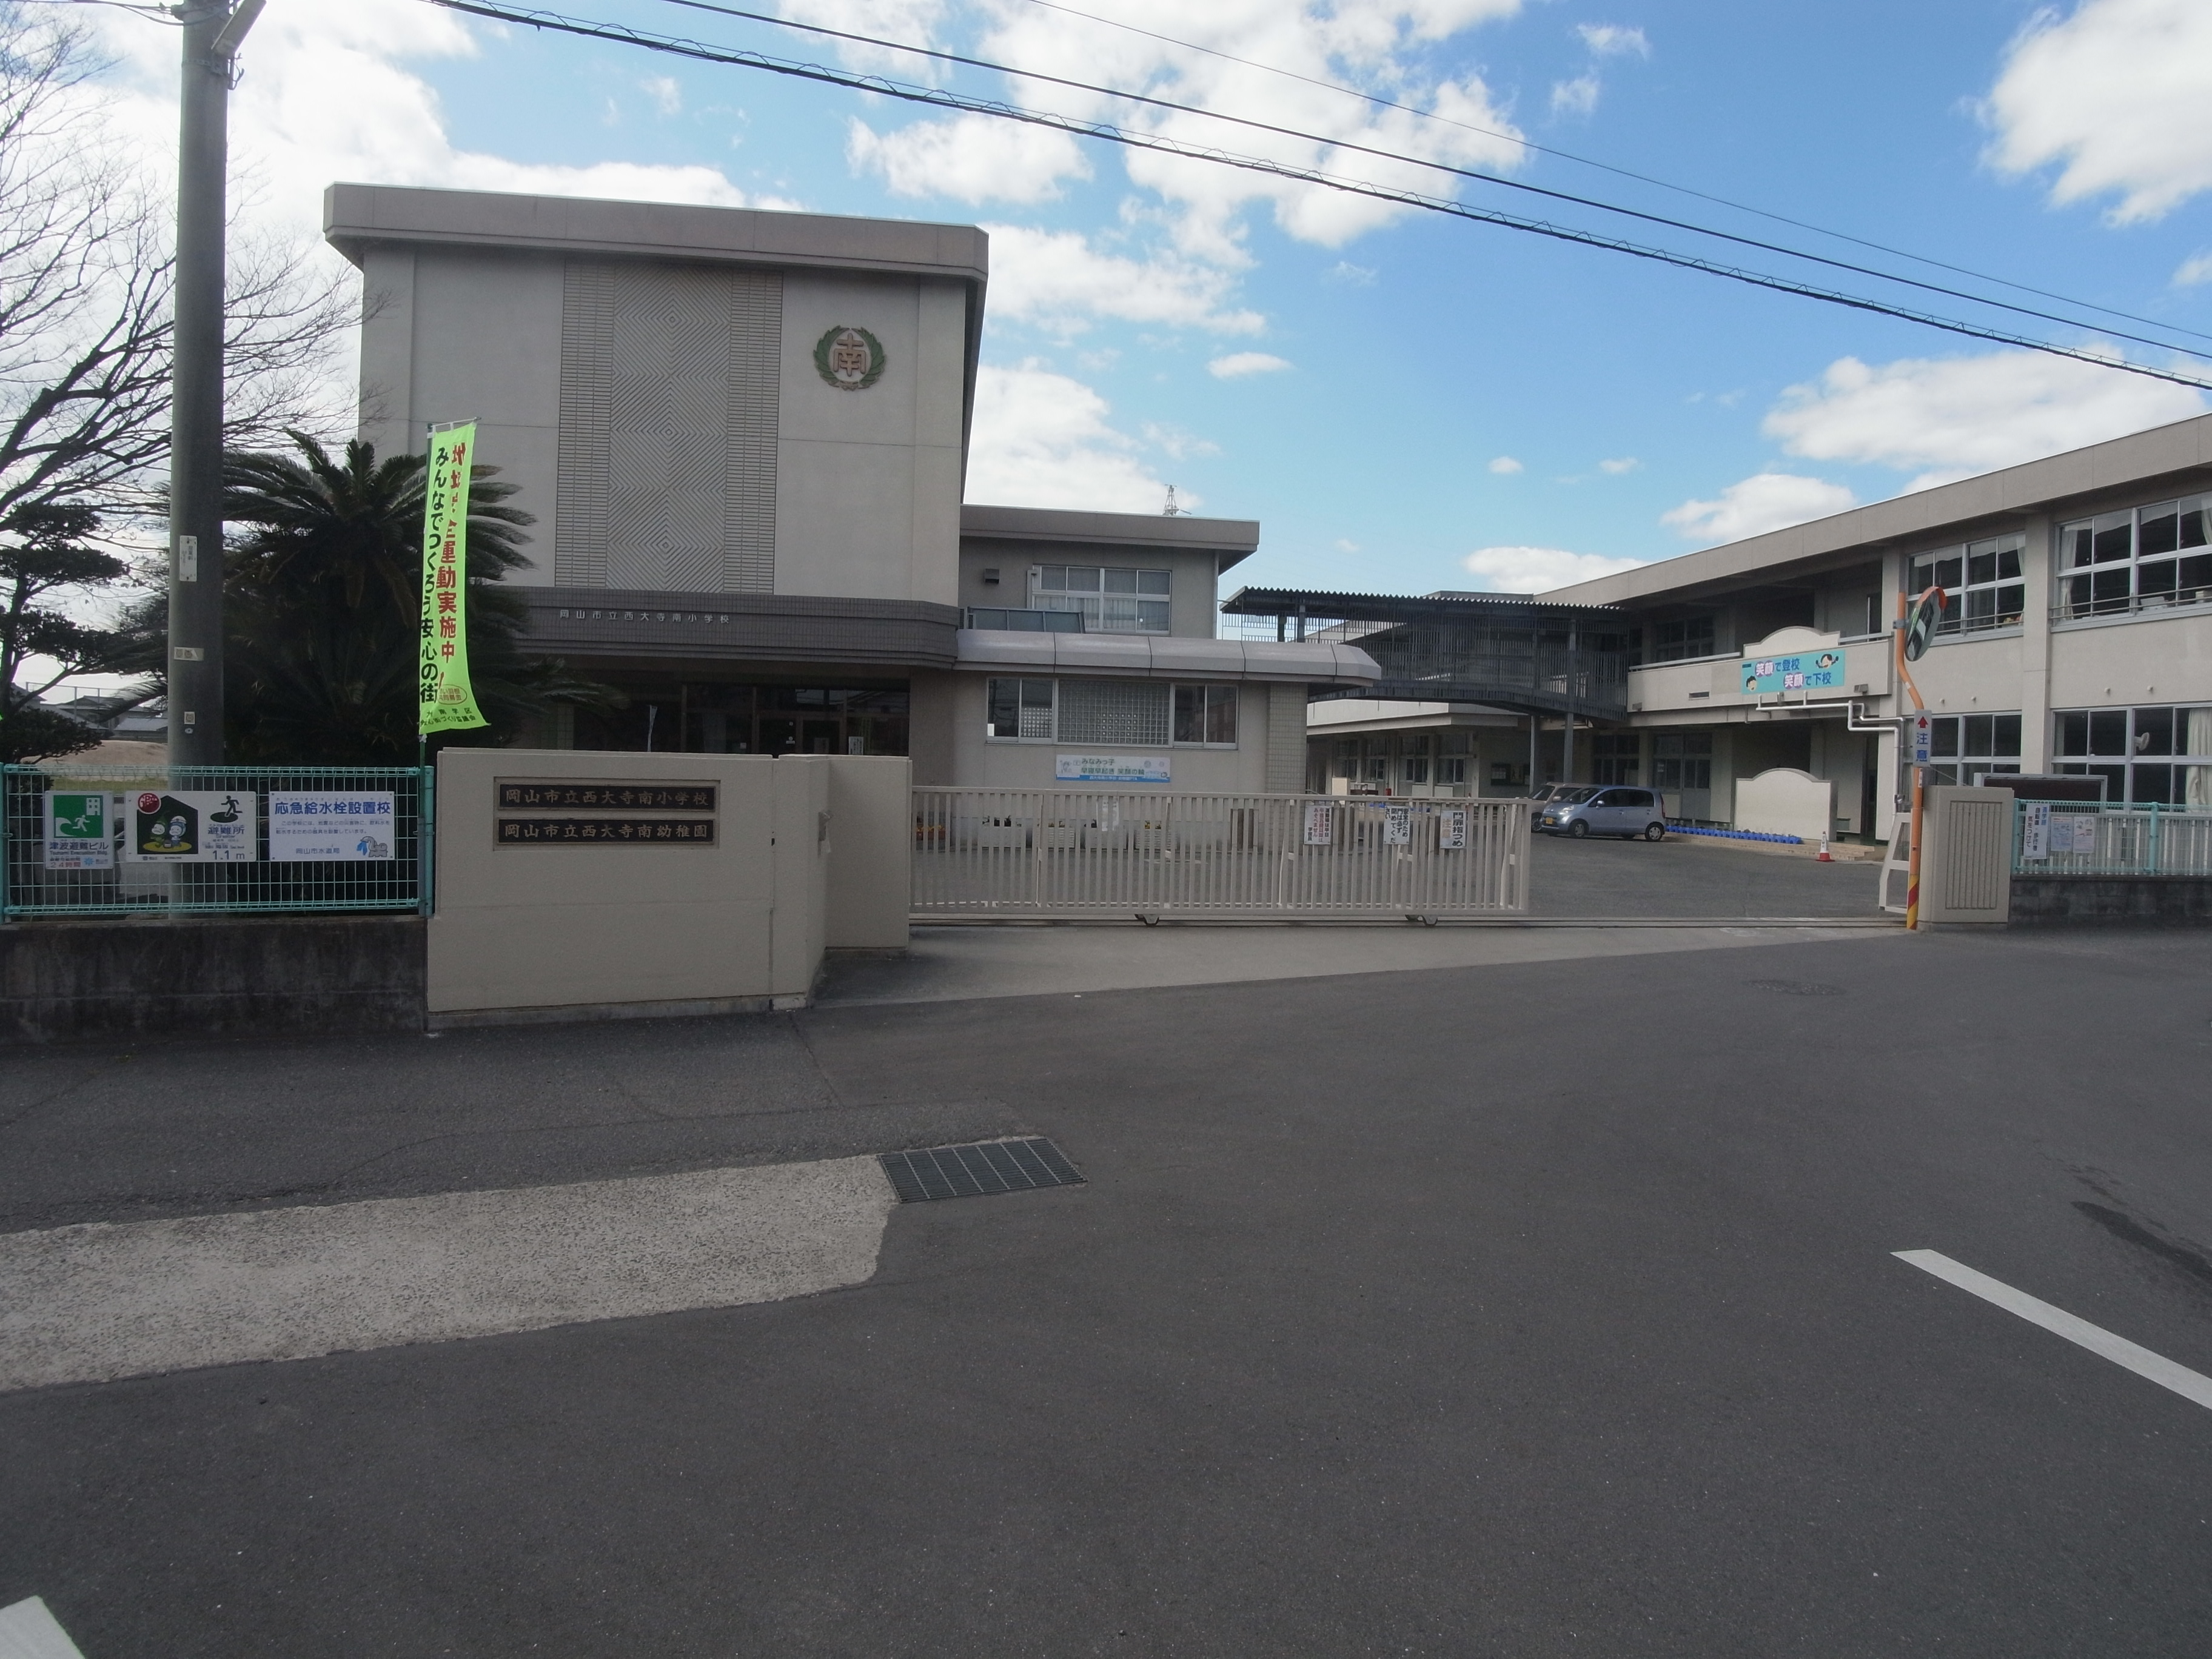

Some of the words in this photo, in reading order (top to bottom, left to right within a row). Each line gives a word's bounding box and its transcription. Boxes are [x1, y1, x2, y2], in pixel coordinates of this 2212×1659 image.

[560, 609, 729, 624] 岡山市立西大寺南小学校
[1756, 659, 1800, 675] 笑顔で登校
[1785, 672, 1831, 688] 笑顔で下校
[1916, 732, 1928, 762] 注意
[506, 789, 709, 806] 岡山市立西大寺南小学校
[275, 802, 390, 814] 応急給水栓設置校
[1385, 808, 1391, 819] さい
[504, 823, 708, 839] 岡山市立西大寺南幼稚園
[1452, 812, 1464, 846] 門扉指つめ
[212, 850, 229, 860] 1.1
